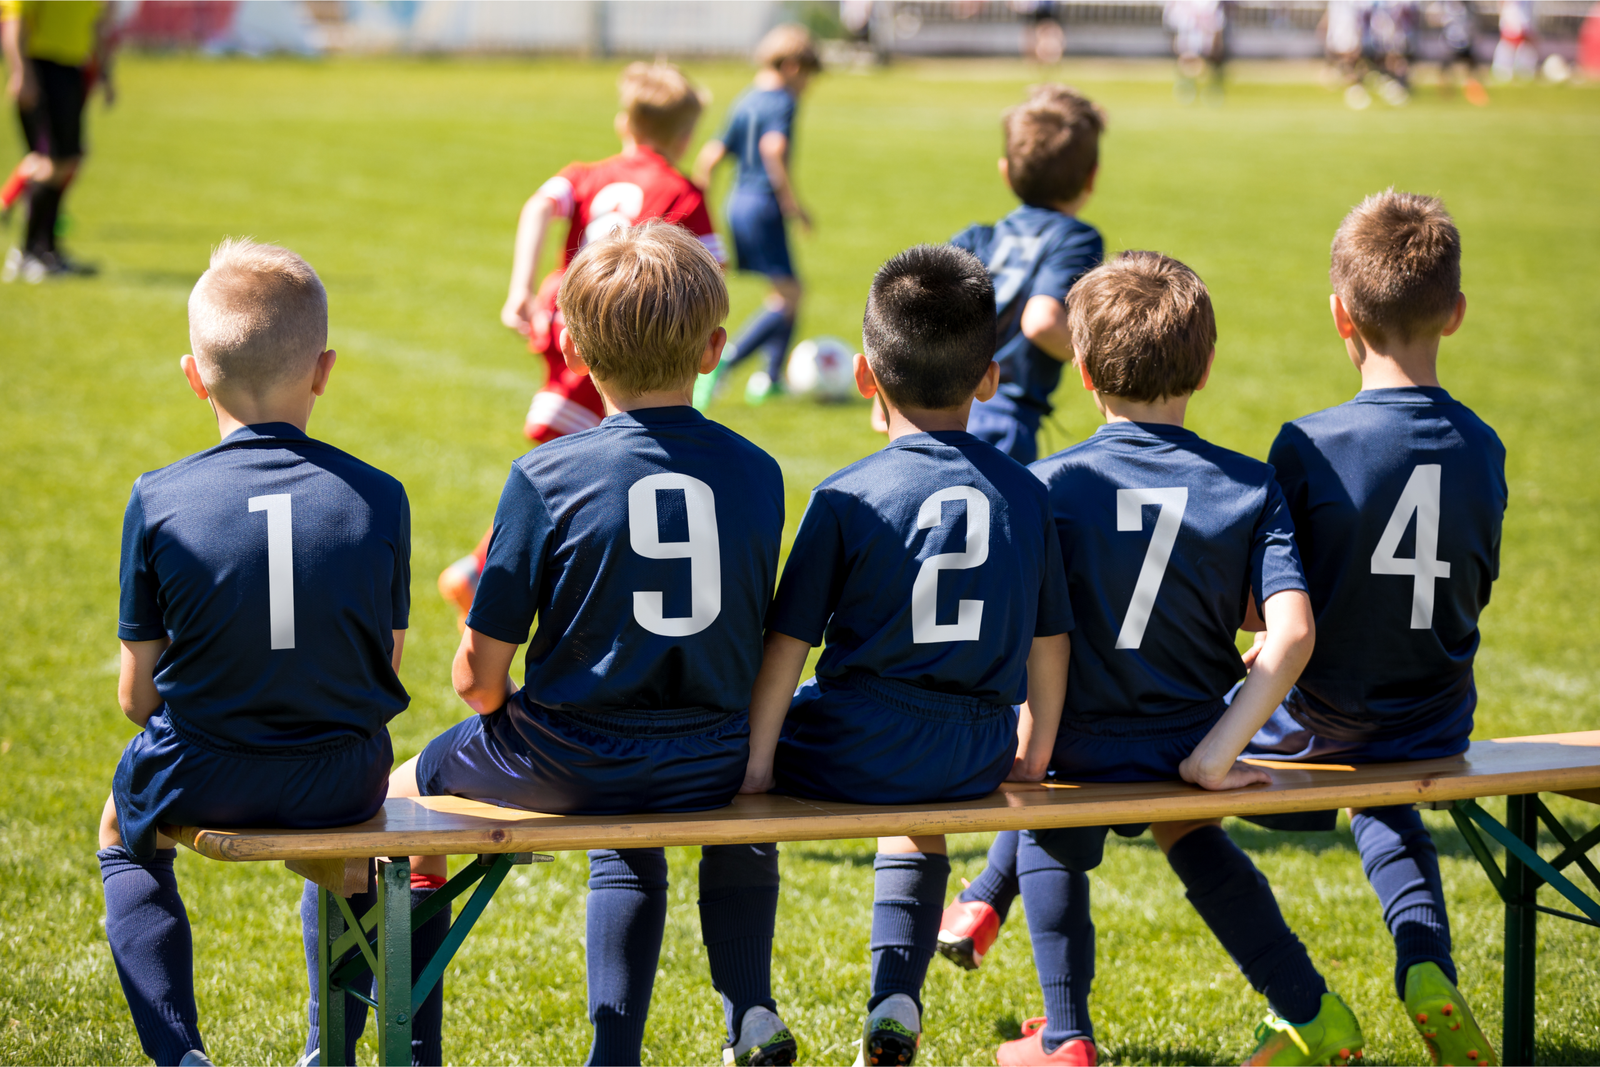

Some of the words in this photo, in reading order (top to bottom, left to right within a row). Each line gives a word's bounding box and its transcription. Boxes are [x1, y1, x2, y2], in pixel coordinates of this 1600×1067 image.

[248, 493, 295, 650] 1
[628, 472, 721, 637] 9
[911, 485, 990, 644] 2
[1116, 487, 1188, 650] 7
[1371, 464, 1451, 629] 4
